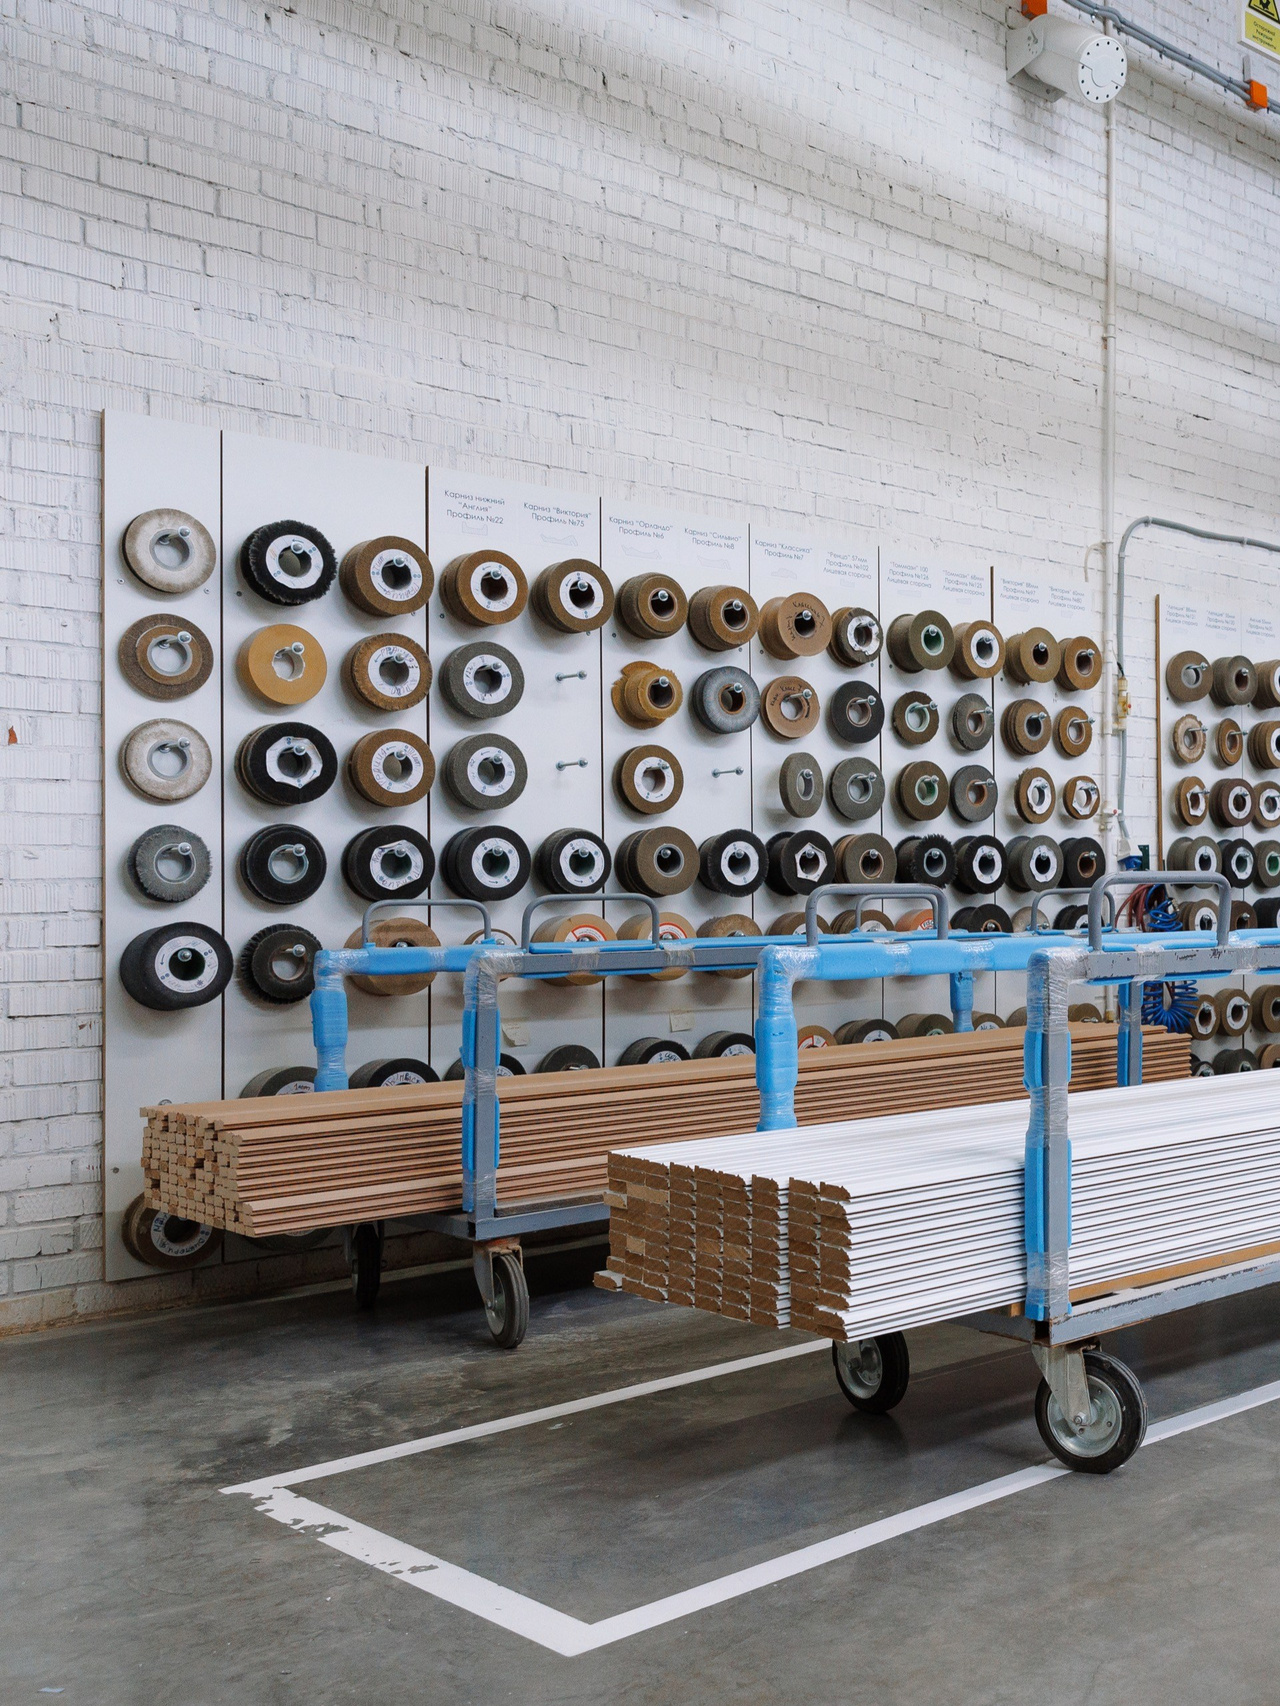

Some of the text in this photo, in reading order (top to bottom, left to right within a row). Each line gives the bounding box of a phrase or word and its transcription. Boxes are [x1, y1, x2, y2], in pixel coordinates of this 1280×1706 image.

[444, 490, 505, 505] Карниз нижний
[458, 501, 492, 512] "Англия"
[523, 502, 592, 519] Карниз "Виктория"
[446, 509, 504, 524] Профиль №22
[531, 512, 585, 528] Профиль №75
[609, 516, 673, 531] Карниз "Орландо"
[618, 526, 665, 540] Профиль №6
[684, 527, 708, 537] Карниз
[692, 537, 735, 550] Профиль №8
[755, 539, 777, 549] Карниз
[764, 549, 793, 560] Профиль
[825, 558, 853, 569] Профиль
[823, 567, 872, 580] Лицевая сторона
[888, 568, 914, 579] Профиль
[886, 576, 932, 589] Лицевая сторона
[944, 577, 968, 587] Профиль
[942, 585, 985, 597] Лицевая сторона
[1002, 585, 1025, 594] Профиль
[999, 592, 1040, 604] Лицевая сторона
[1050, 592, 1072, 602] Профиль
